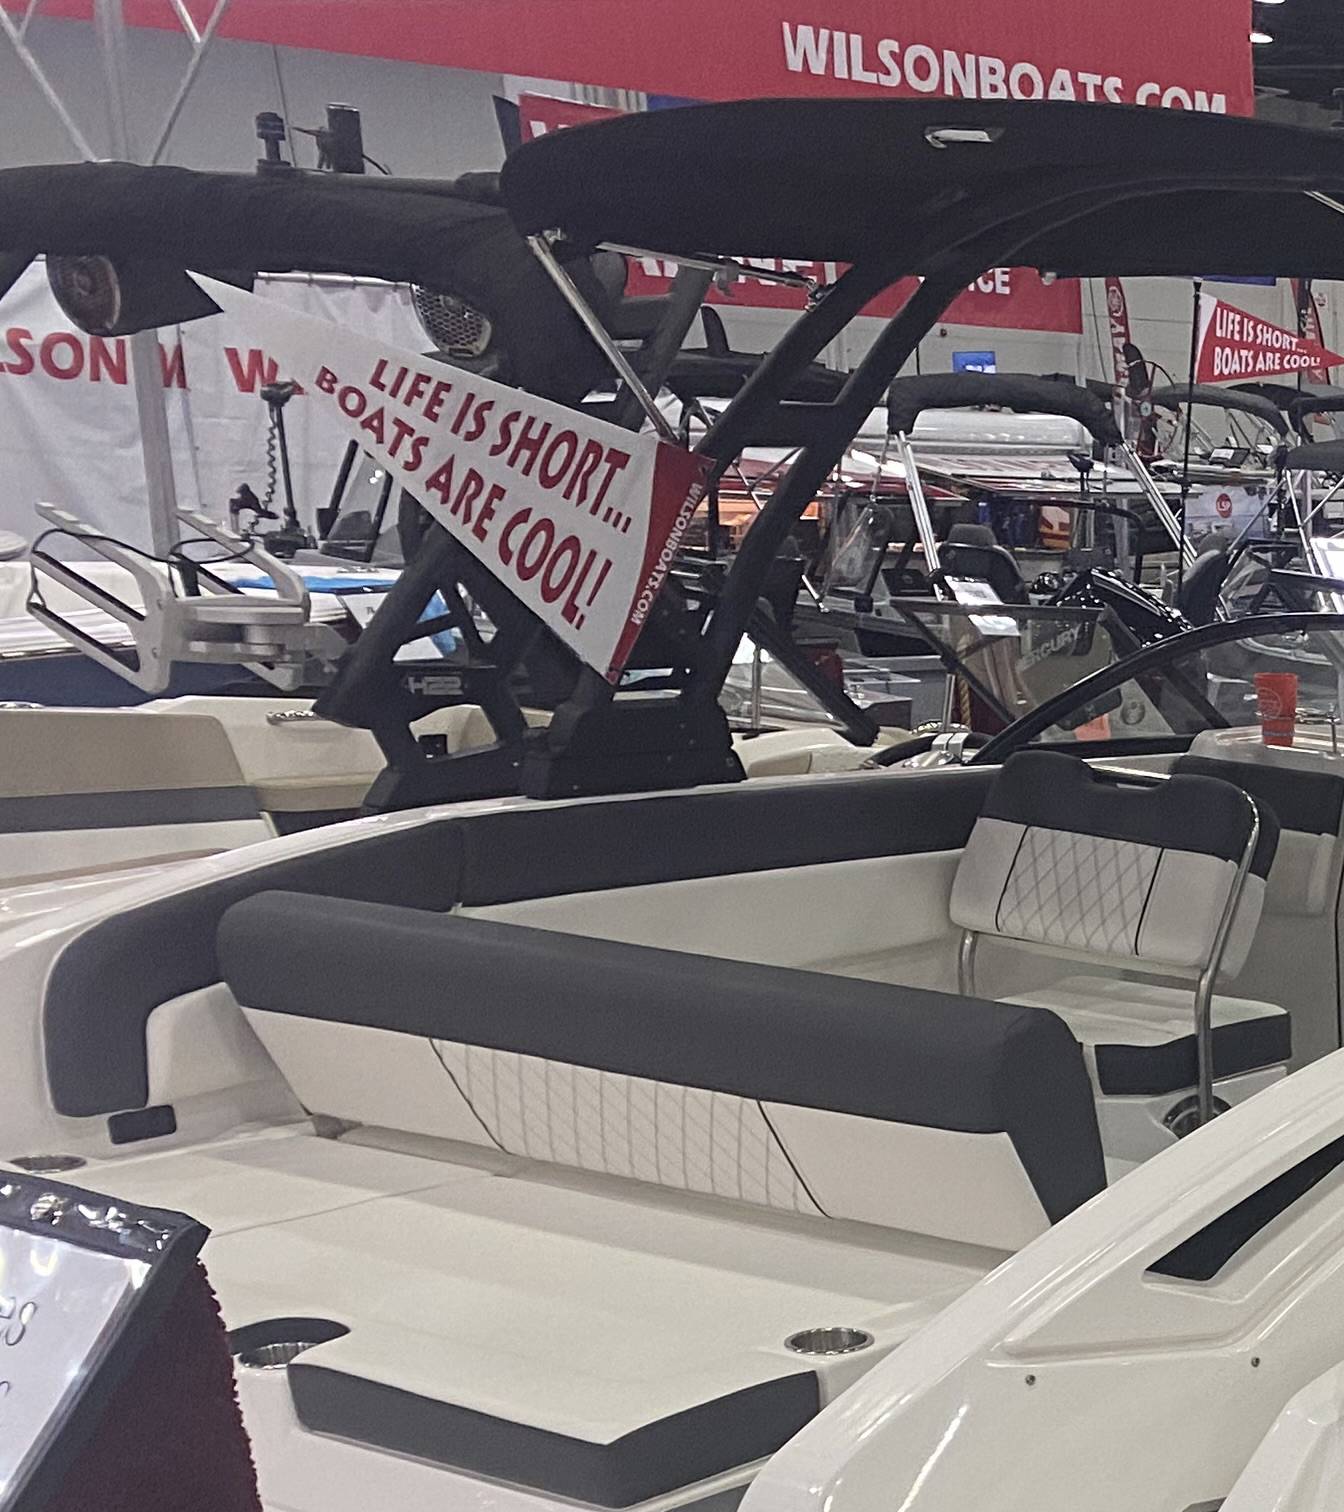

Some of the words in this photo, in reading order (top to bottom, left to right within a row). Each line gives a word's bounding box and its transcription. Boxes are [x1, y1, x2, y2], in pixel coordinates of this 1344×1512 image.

[782, 21, 1227, 115] WILSONBOATSCOM
[0, 327, 128, 386] SON
[1213, 347, 1254, 376] BOATS
[1255, 352, 1282, 372] ARE
[1283, 353, 1322, 369] COOL!
[1215, 307, 1242, 341] LIFE
[1243, 318, 1255, 343] IS
[369, 358, 453, 423] LIFE
[450, 392, 495, 442] IS
[489, 410, 633, 534] SHORT...
[314, 365, 431, 472] BOATS
[425, 454, 507, 543] ARE
[498, 506, 613, 631] COOL!
[631, 482, 702, 626] WILSONBOATS.COM
